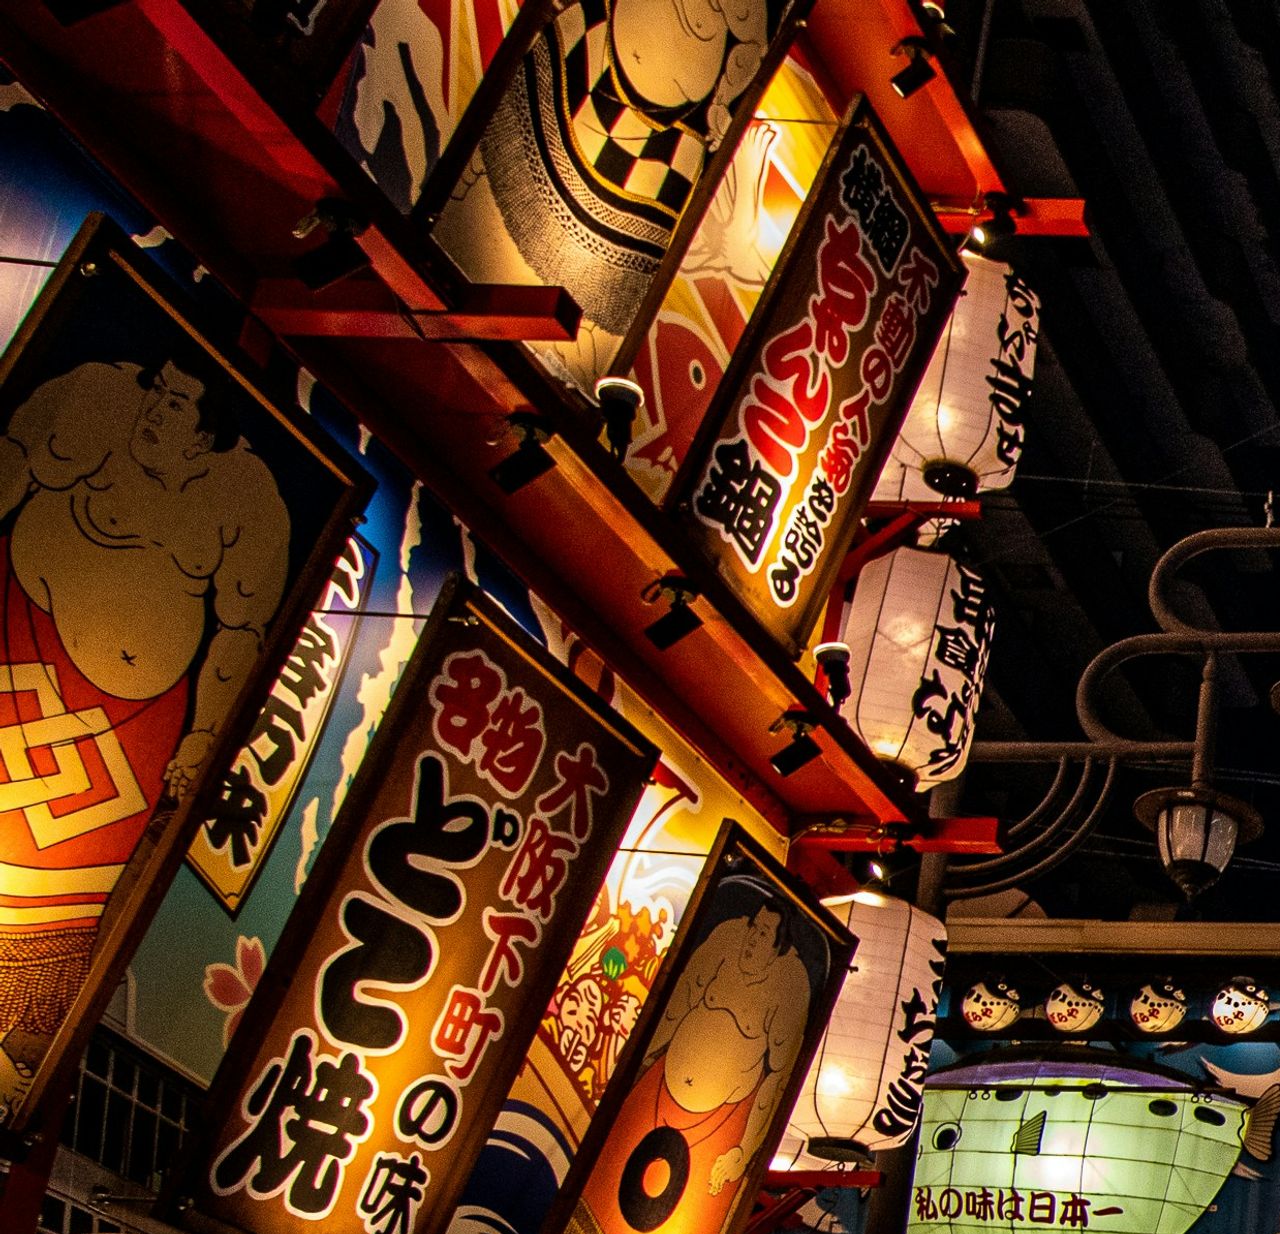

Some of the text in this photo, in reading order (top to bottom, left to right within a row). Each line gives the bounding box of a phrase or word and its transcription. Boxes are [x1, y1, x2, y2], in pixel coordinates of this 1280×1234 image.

[915, 1187, 1123, 1228] 私の味は日本一
